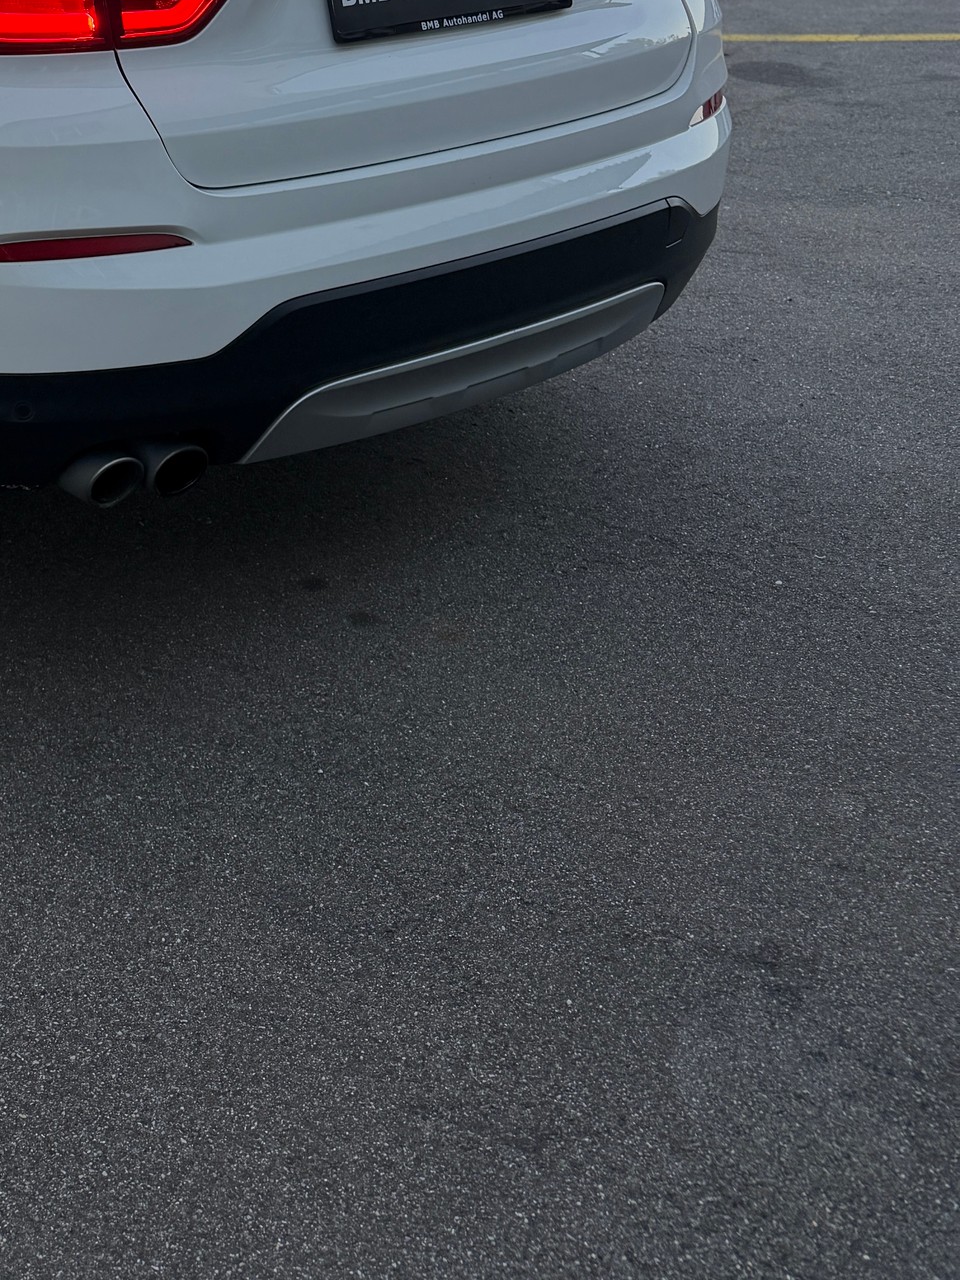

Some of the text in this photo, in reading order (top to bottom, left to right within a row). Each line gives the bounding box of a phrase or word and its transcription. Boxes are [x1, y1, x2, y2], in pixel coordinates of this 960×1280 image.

[421, 9, 504, 31] BMB Autohandel AG
